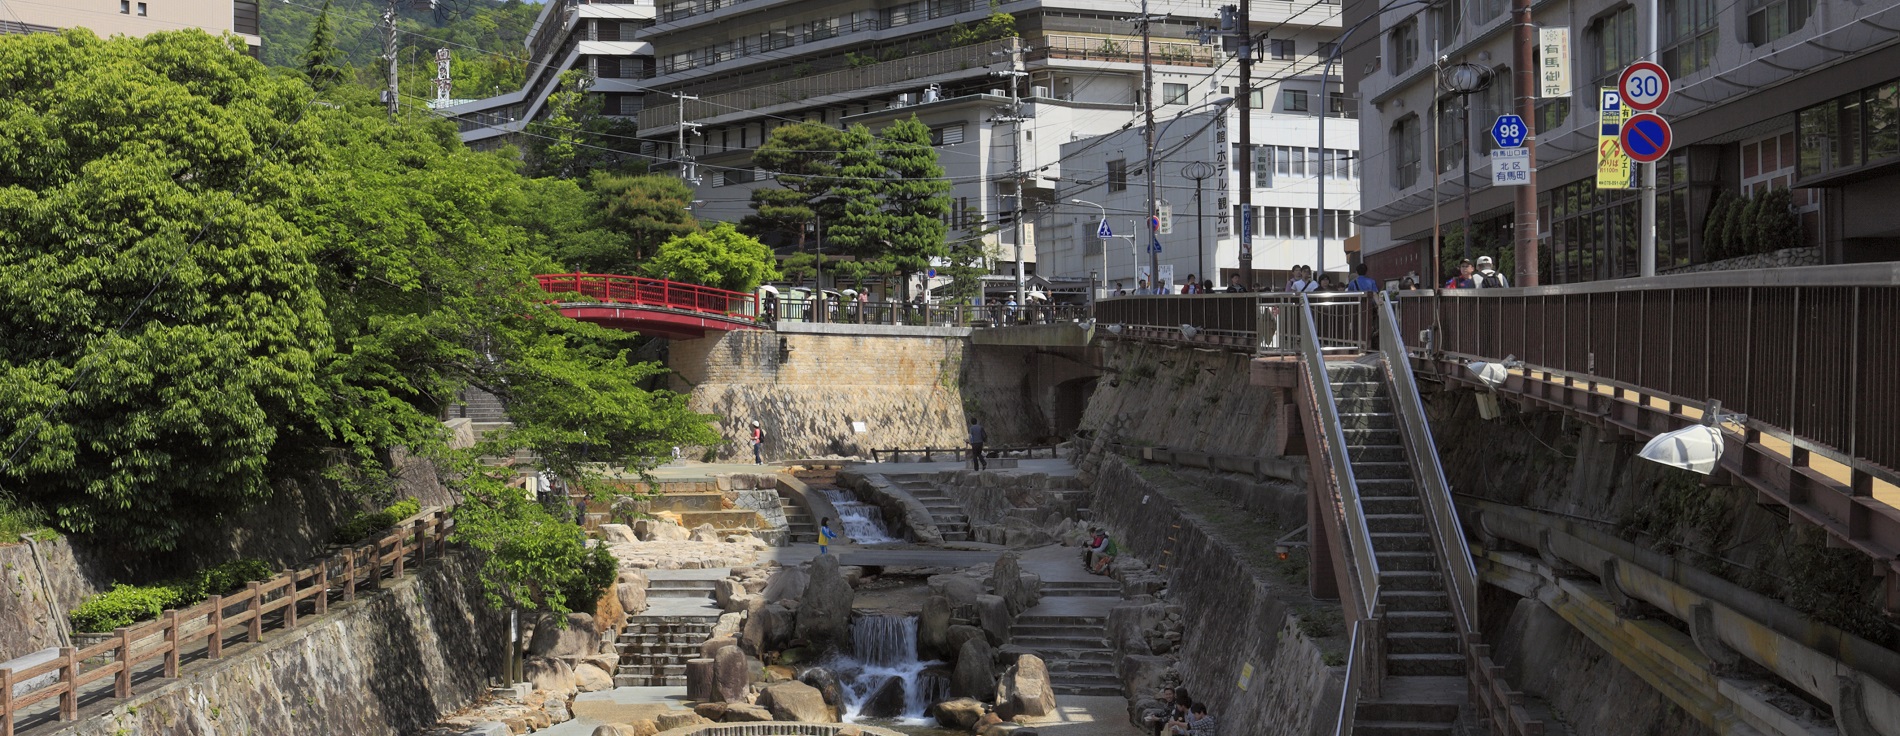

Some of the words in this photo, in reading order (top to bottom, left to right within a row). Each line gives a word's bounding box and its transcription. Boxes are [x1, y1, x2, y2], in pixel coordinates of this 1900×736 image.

[1545, 44, 1560, 95] 有馬御苑
[1631, 76, 1658, 97] 30
[1605, 93, 1618, 109] P
[1500, 124, 1519, 138] 98
[1501, 162, 1521, 170] 北区
[1600, 159, 1618, 167] のりば
[1496, 171, 1527, 181] 有馬町
